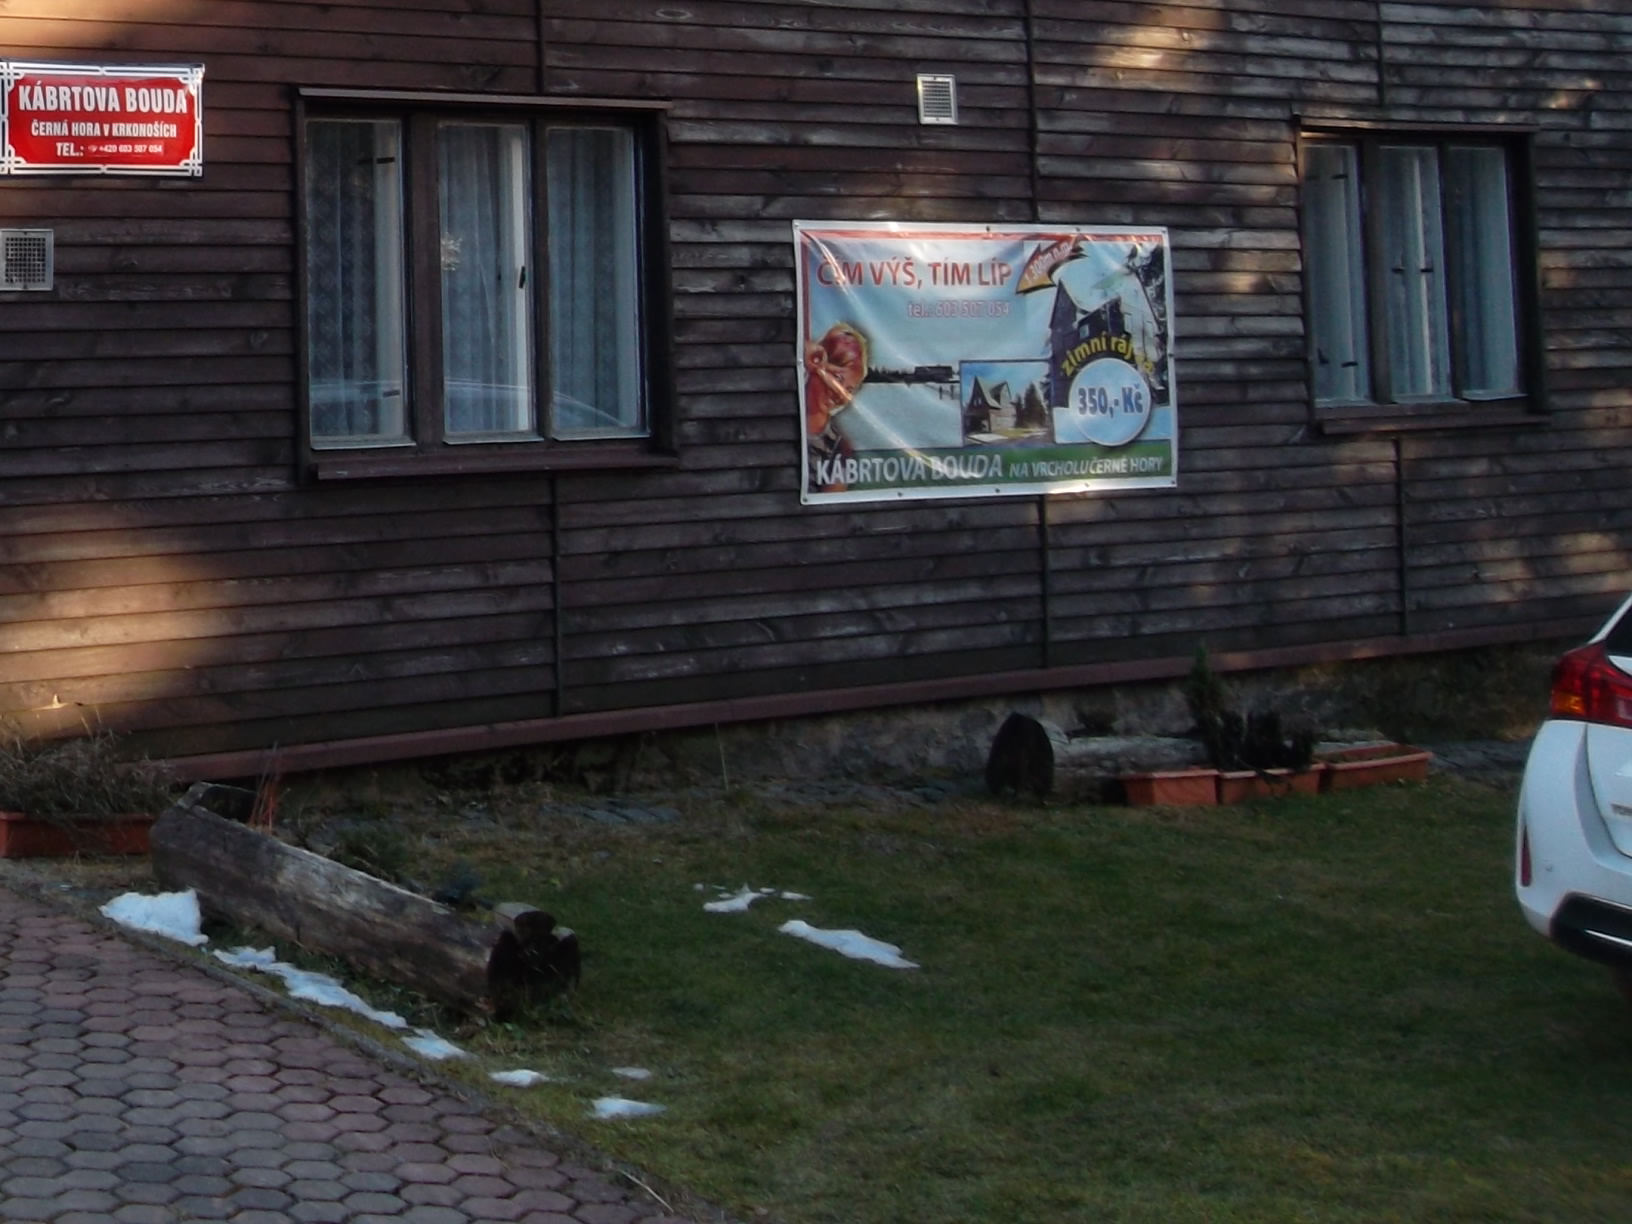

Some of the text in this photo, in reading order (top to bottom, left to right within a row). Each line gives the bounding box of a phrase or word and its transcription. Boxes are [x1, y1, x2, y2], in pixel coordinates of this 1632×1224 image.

[18, 81, 188, 114] KÁBRTOVA BOUDA
[31, 119, 69, 137] ČERNÁ
[71, 122, 101, 137] HORA
[112, 120, 178, 138] KRKONOŠÍCH
[56, 143, 85, 157] TEL.:
[869, 256, 922, 289] VÝŠ,
[928, 257, 971, 286] TÍM
[977, 257, 1012, 286] LÍP
[935, 299, 958, 318] 603
[960, 299, 985, 318] 507
[987, 299, 1011, 318] 054
[1062, 331, 1107, 376] zimní
[1077, 383, 1144, 418] 350,- Kč
[816, 454, 1164, 485] KÁBRTOVA BOUDA NA VRCHOLU ČERNÉ HORY
